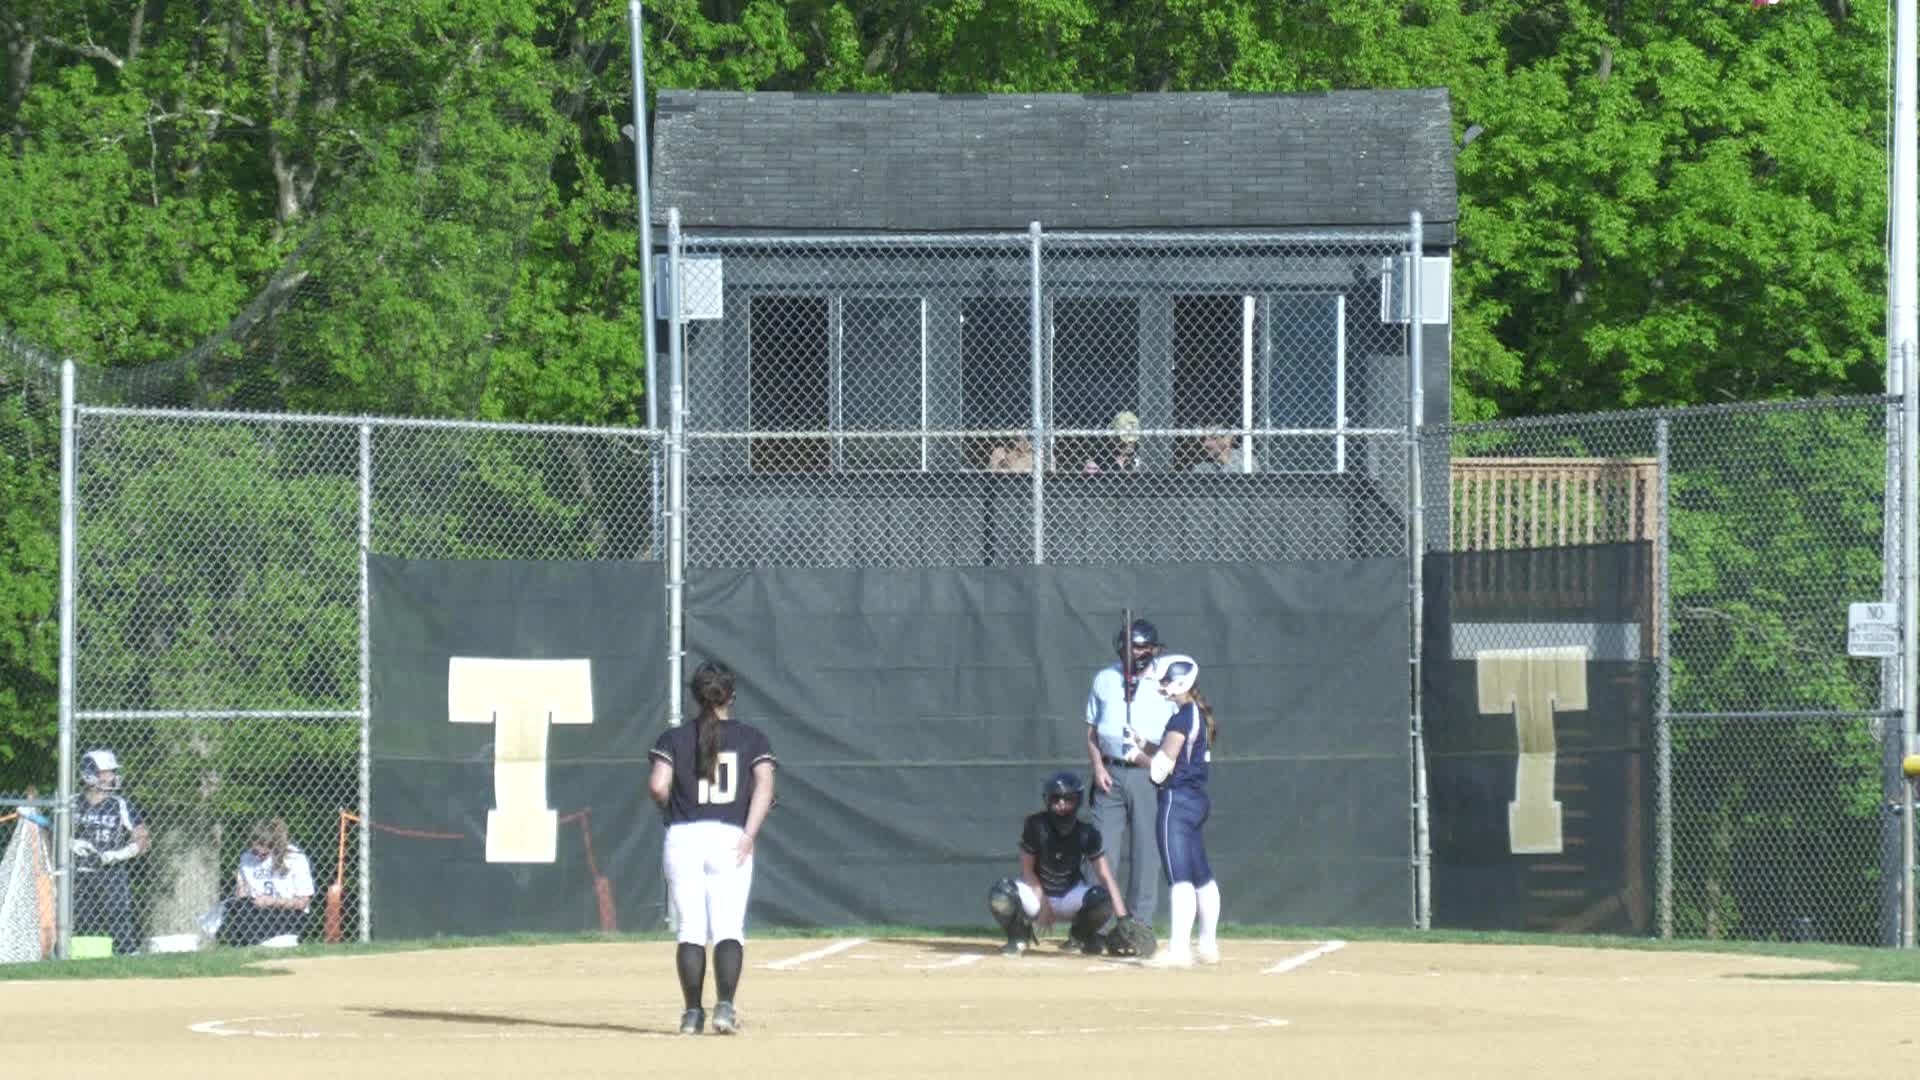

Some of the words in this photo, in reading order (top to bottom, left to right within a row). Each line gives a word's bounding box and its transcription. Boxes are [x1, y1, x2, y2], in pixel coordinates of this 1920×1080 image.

[1866, 605, 1884, 620] NO
[448, 657, 593, 863] T
[1477, 646, 1588, 854] T
